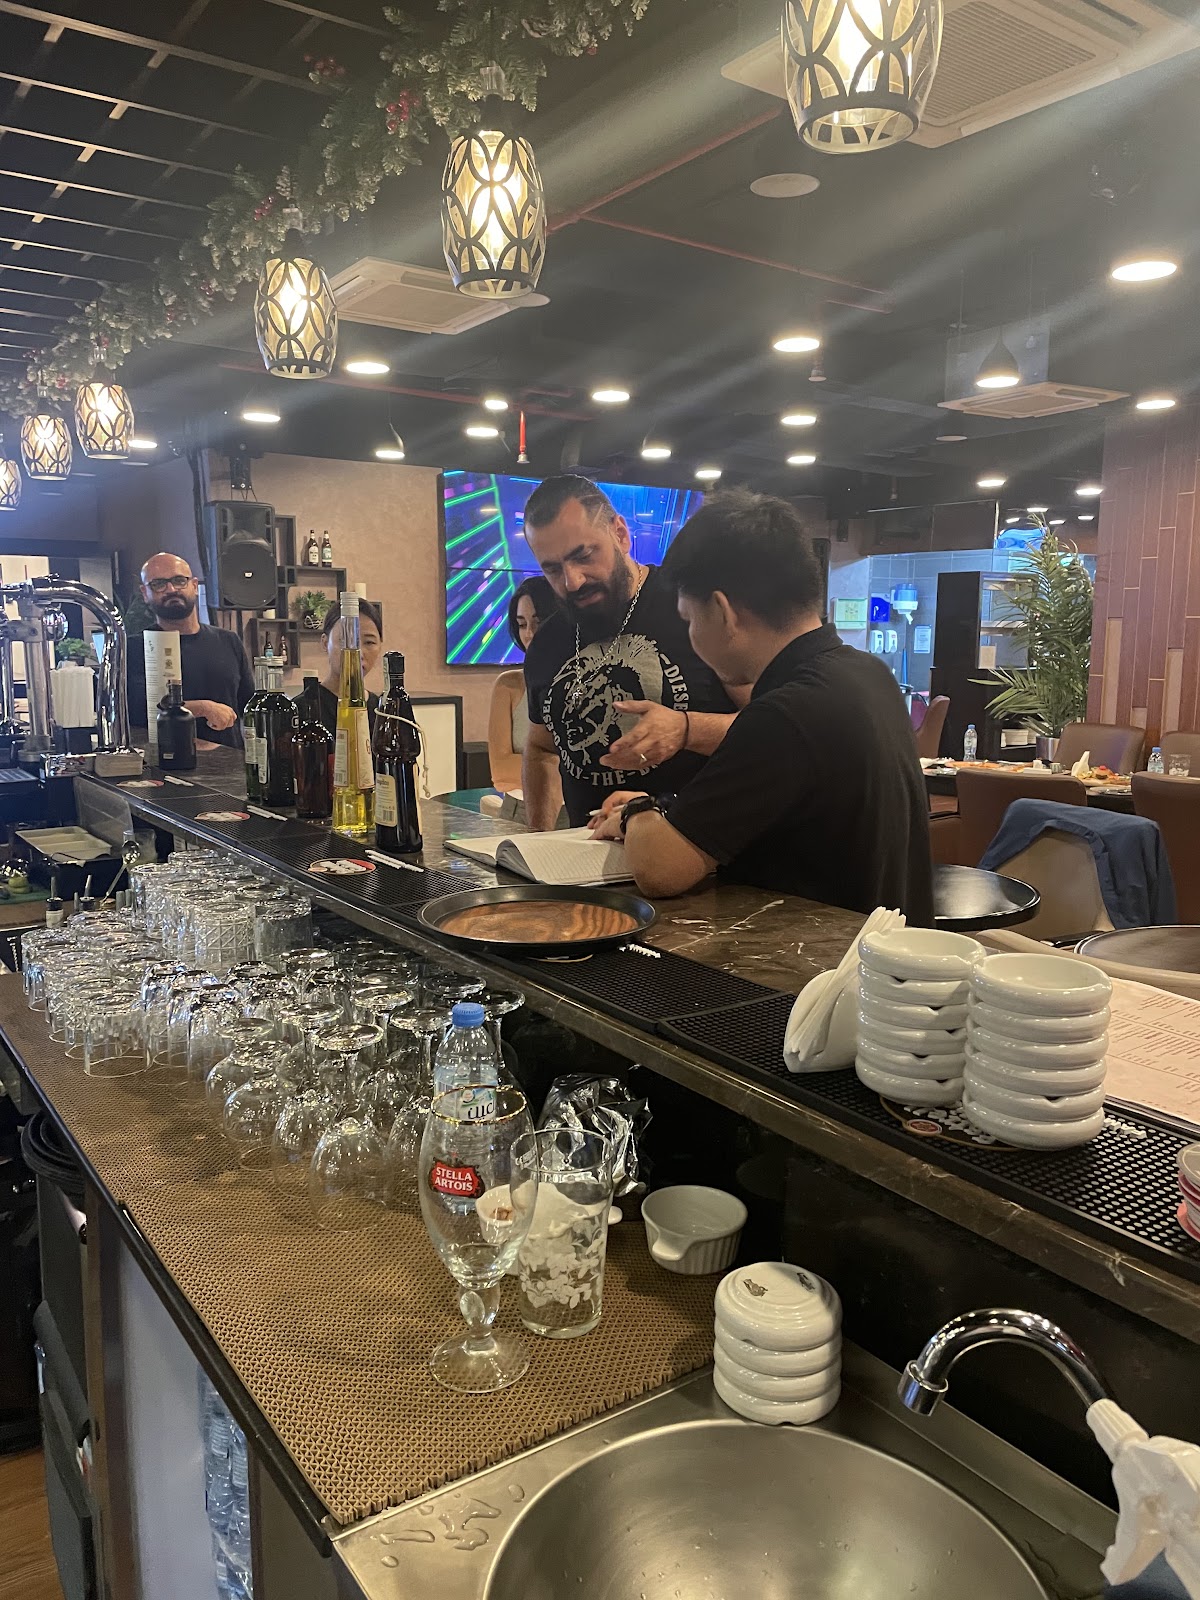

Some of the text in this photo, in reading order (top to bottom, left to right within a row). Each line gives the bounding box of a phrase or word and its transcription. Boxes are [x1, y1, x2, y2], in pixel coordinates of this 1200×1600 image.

[664, 664, 689, 711] DIESE
[590, 770, 626, 786] THE
[436, 1166, 472, 1181] STELLA
[435, 1176, 473, 1191] ARTOIS
